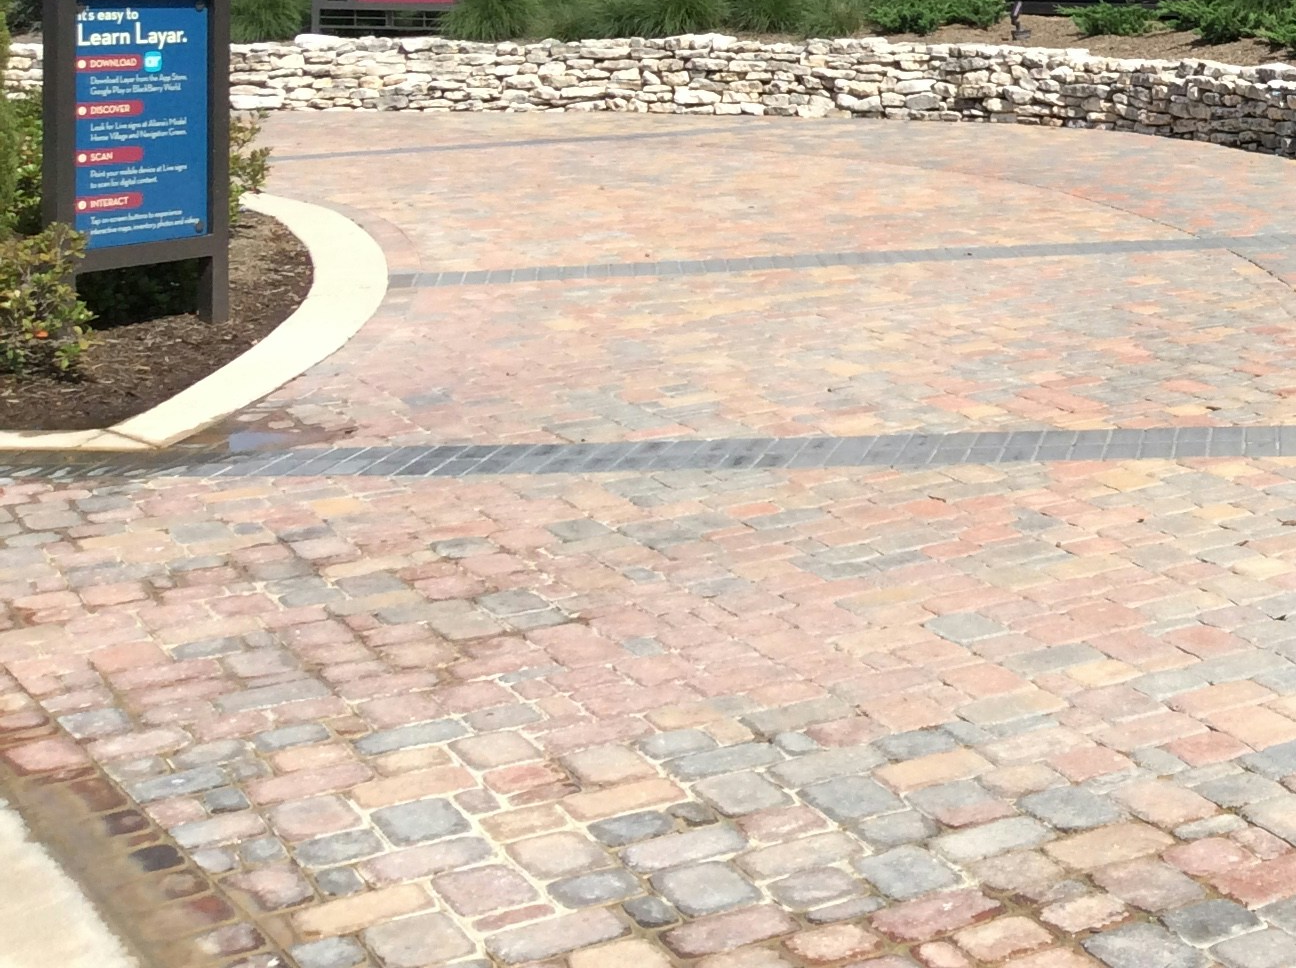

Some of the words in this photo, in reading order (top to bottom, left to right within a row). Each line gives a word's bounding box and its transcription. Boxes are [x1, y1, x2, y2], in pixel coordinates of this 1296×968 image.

[97, 11, 124, 24] easy
[126, 7, 139, 20] to
[77, 22, 131, 47] Learn
[135, 21, 188, 49] Layar.
[90, 58, 137, 68] DOWNLOAD
[90, 104, 131, 115] DISCOVER
[90, 152, 114, 162] SCAN
[90, 196, 130, 209] INTERACT
